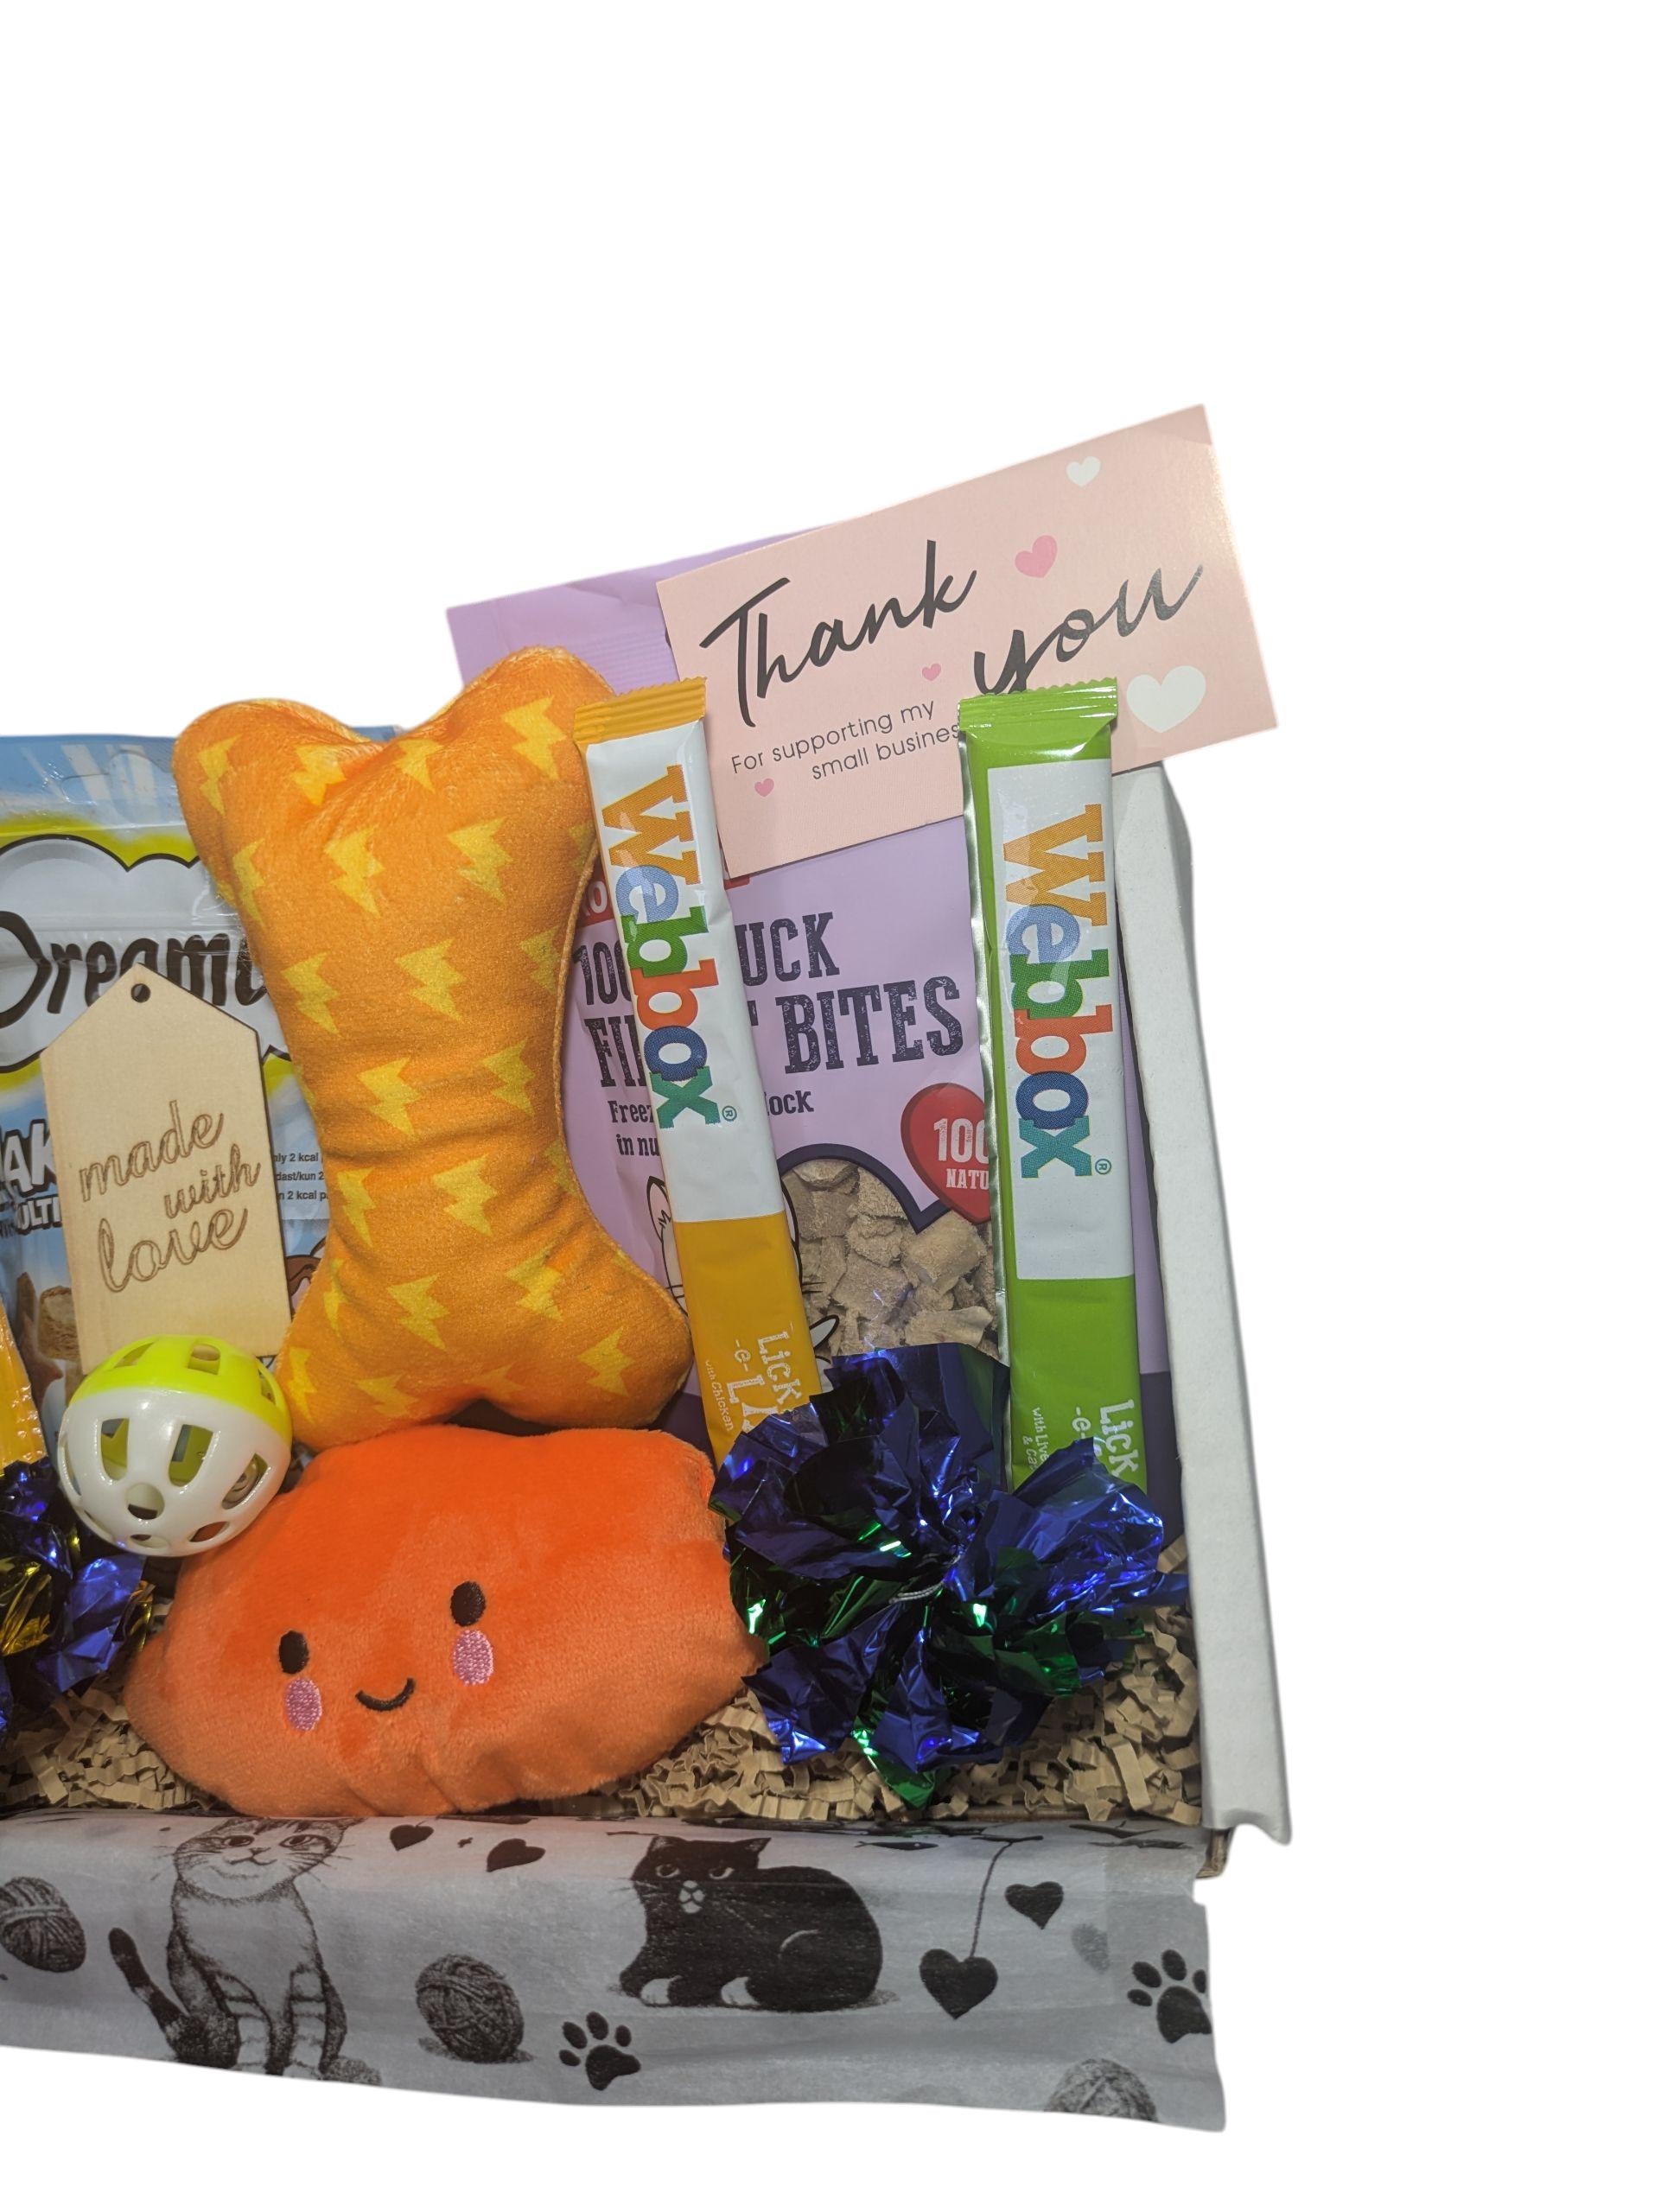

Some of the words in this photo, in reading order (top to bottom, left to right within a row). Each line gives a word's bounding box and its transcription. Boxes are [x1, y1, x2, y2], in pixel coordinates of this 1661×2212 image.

[698, 539, 978, 728] Thank
[973, 563, 1205, 696] you
[731, 752, 764, 774] For
[772, 713, 894, 763] supporting
[900, 700, 935, 723] my
[811, 747, 869, 780] small
[601, 764, 722, 1130] Webbox
[774, 975, 964, 1074] BITES
[1002, 803, 1115, 1180] Webbox
[79, 1099, 225, 1203] made
[163, 1143, 262, 1219] with
[290, 1153, 296, 1162] 2
[298, 1152, 319, 1162] kcal
[616, 1134, 635, 1156] in
[287, 1191, 294, 1200] 2
[296, 1190, 317, 1200] kcal
[97, 1207, 249, 1294] love
[1032, 1407, 1047, 1433] with
